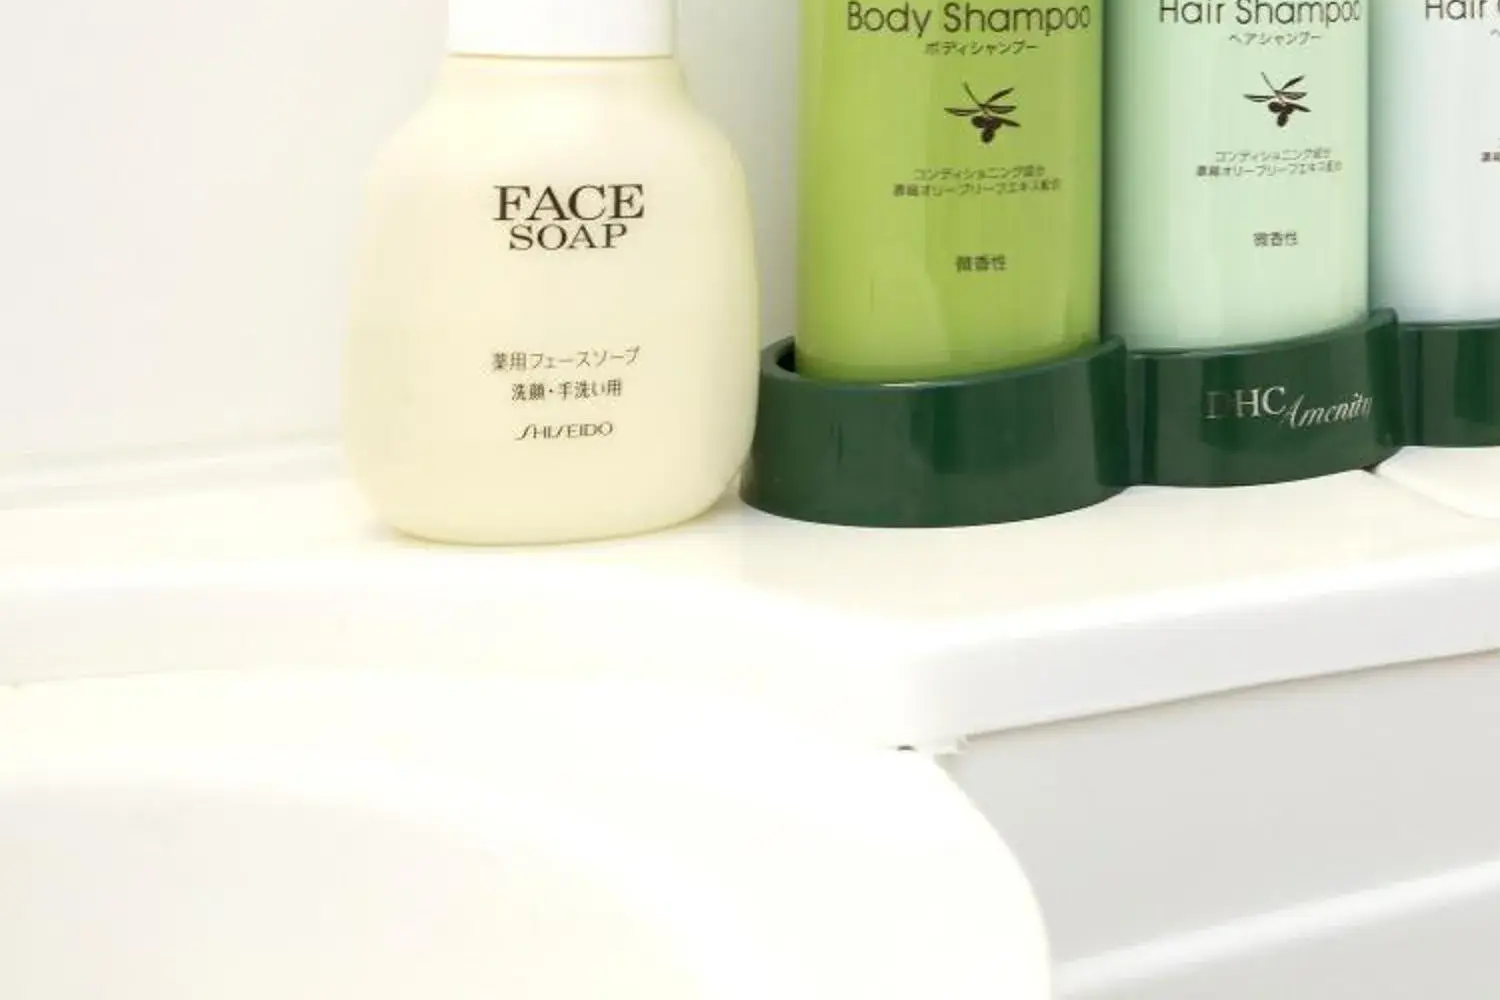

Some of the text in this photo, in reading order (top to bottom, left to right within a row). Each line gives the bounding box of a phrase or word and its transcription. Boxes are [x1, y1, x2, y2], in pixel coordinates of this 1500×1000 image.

[847, 0, 1090, 38] Body Shampoo
[1229, 31, 1322, 45] ヘアシャンプー
[493, 183, 645, 221] FACE
[509, 223, 628, 250] SOAP
[493, 346, 641, 371] 薬用フェースソープ
[512, 378, 622, 401] 洗顔・手洗い用
[1281, 392, 1373, 430] Amenity
[514, 420, 614, 441] SHISEIDO
